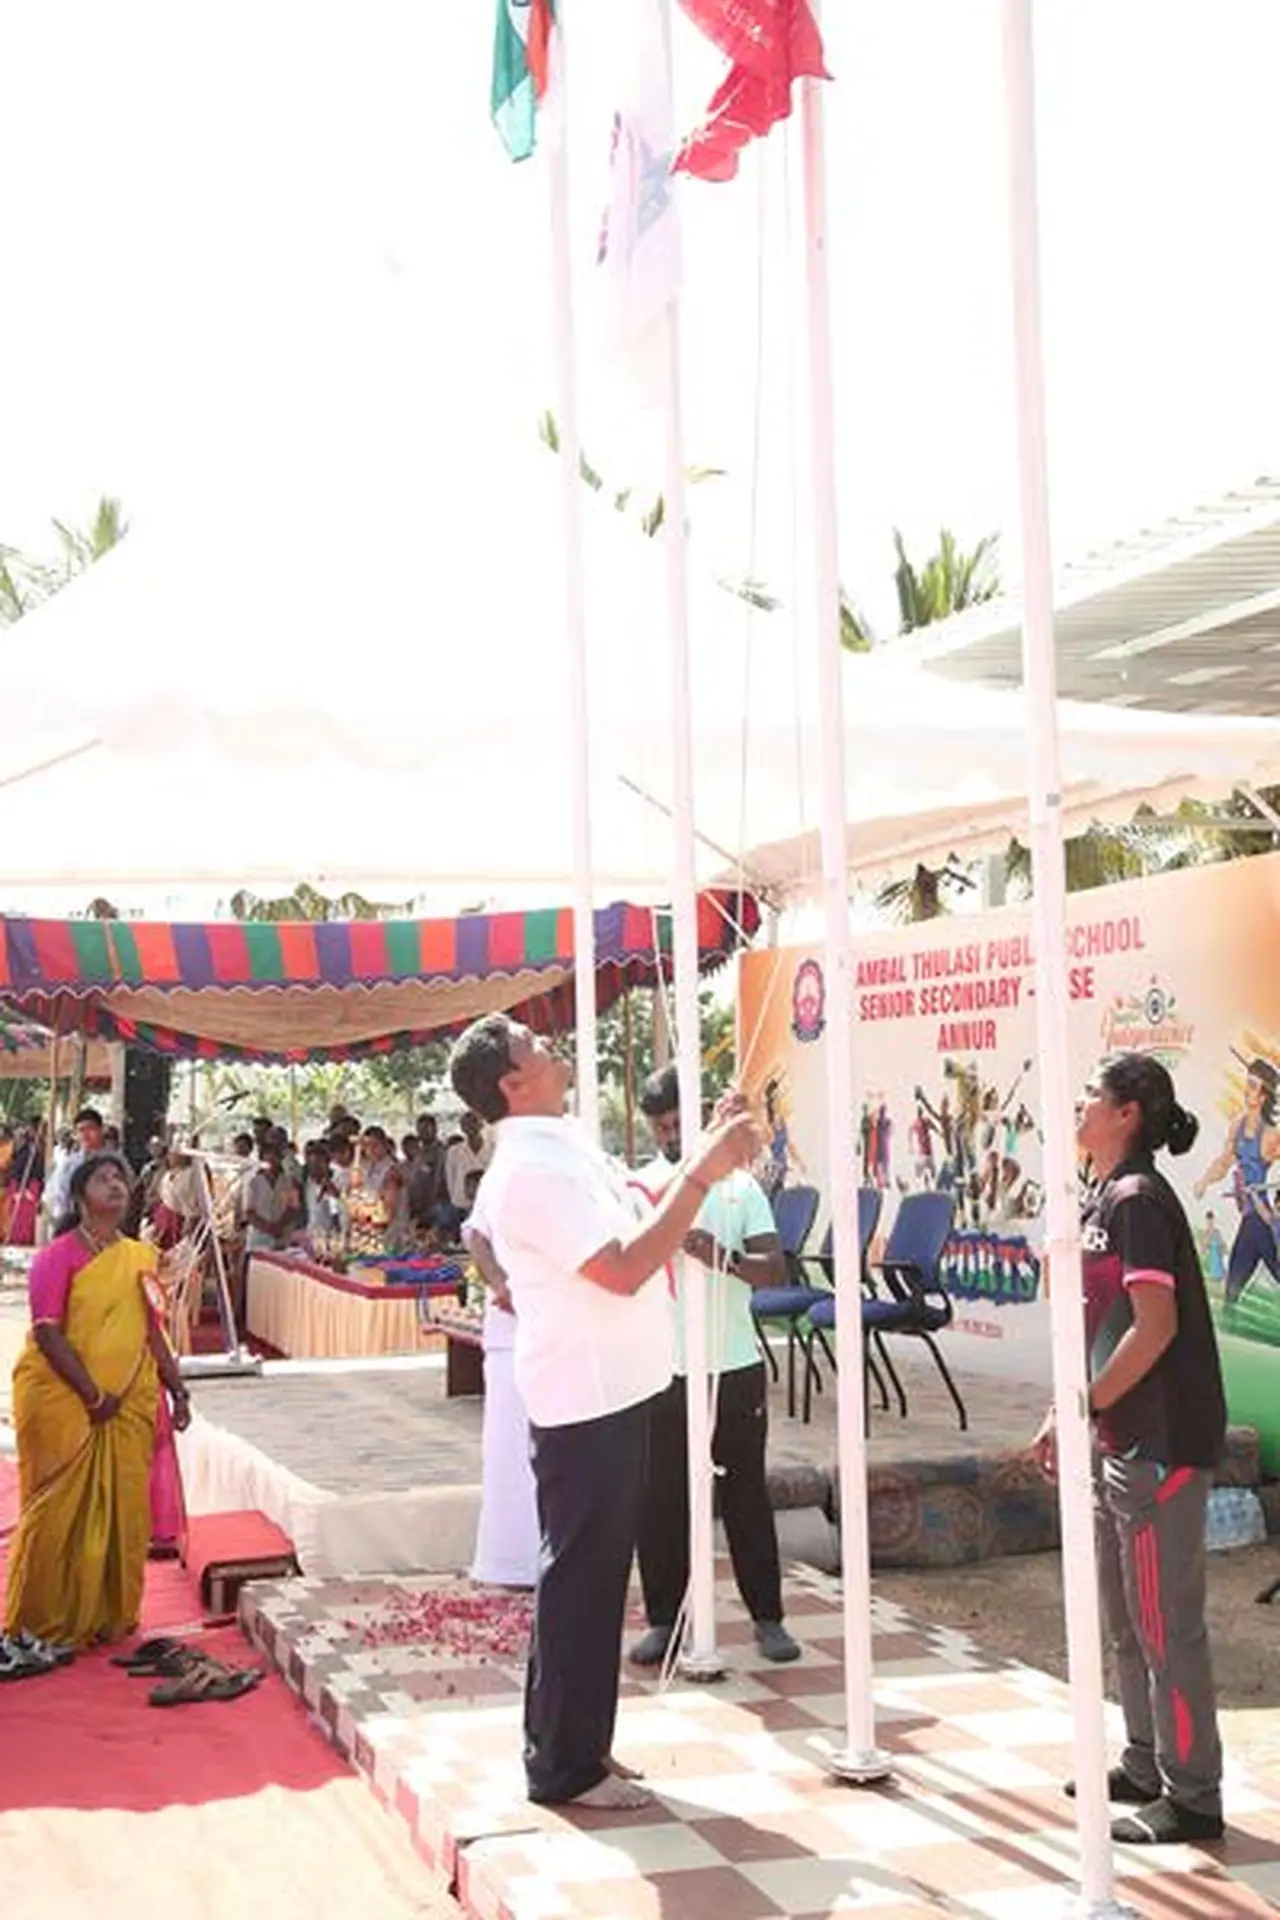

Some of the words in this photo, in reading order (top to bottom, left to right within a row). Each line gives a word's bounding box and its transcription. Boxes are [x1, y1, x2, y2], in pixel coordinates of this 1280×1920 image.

[855, 956, 907, 986] AMBAL
[912, 943, 981, 980] THULASI
[986, 935, 1036, 970] PUBL
[859, 988, 916, 1022] SENIOR
[918, 975, 1023, 1016] SECONDARY
[1068, 966, 1095, 1000] SE
[937, 1019, 998, 1052] ANNUR
[938, 1238, 1038, 1296] PORTS
